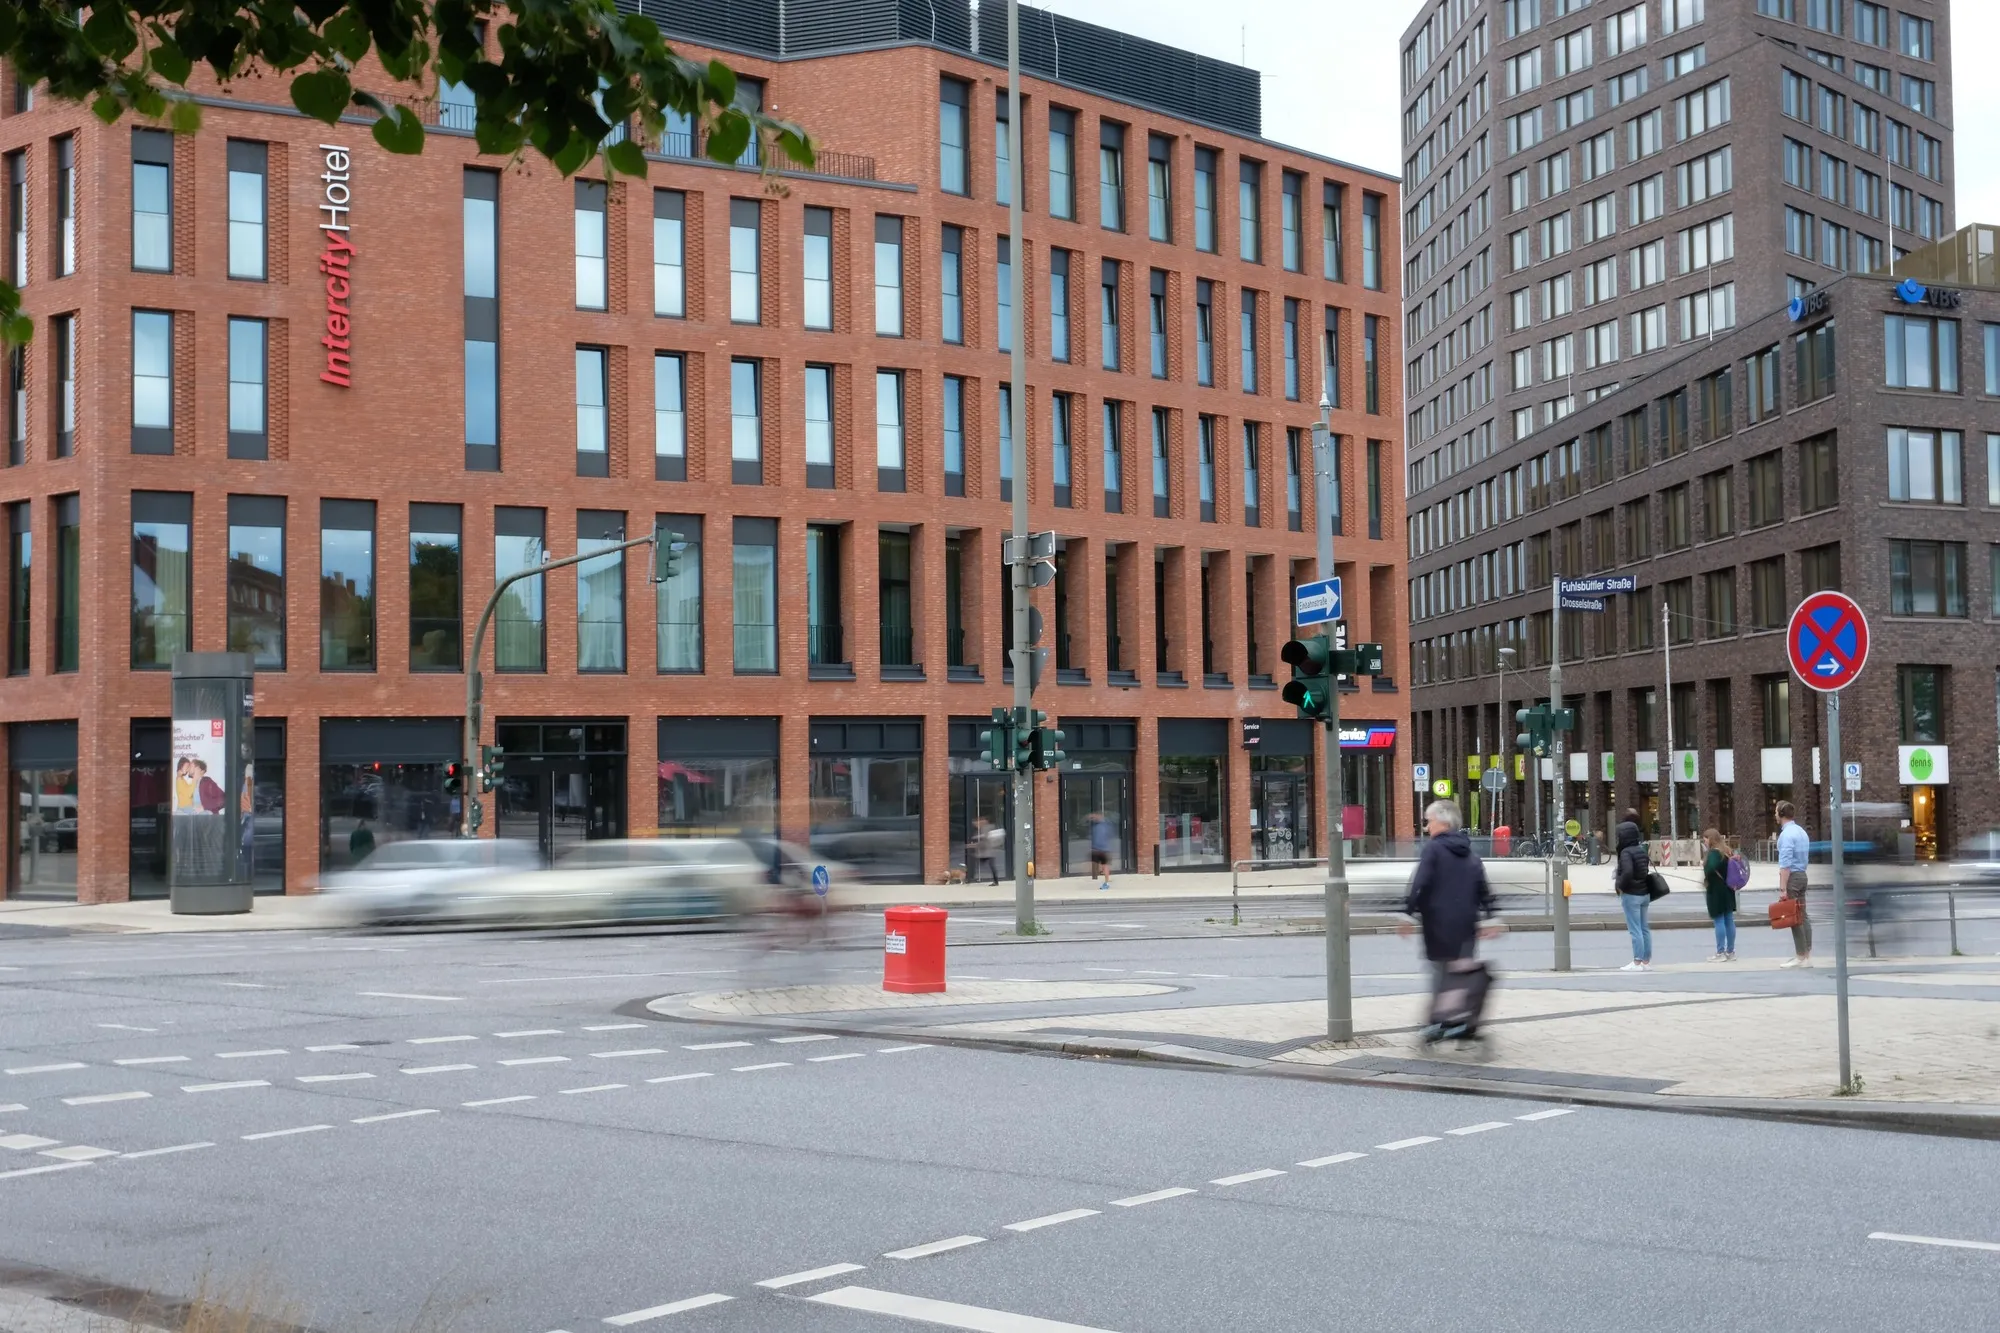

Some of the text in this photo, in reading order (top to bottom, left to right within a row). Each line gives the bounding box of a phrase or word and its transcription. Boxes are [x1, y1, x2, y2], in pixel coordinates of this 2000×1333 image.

[1803, 293, 1824, 316] VBG
[1928, 287, 1962, 308] VBG
[1561, 578, 1632, 592] Fuhlsbüttler Straße
[1561, 596, 1603, 610] Drosselstraße
